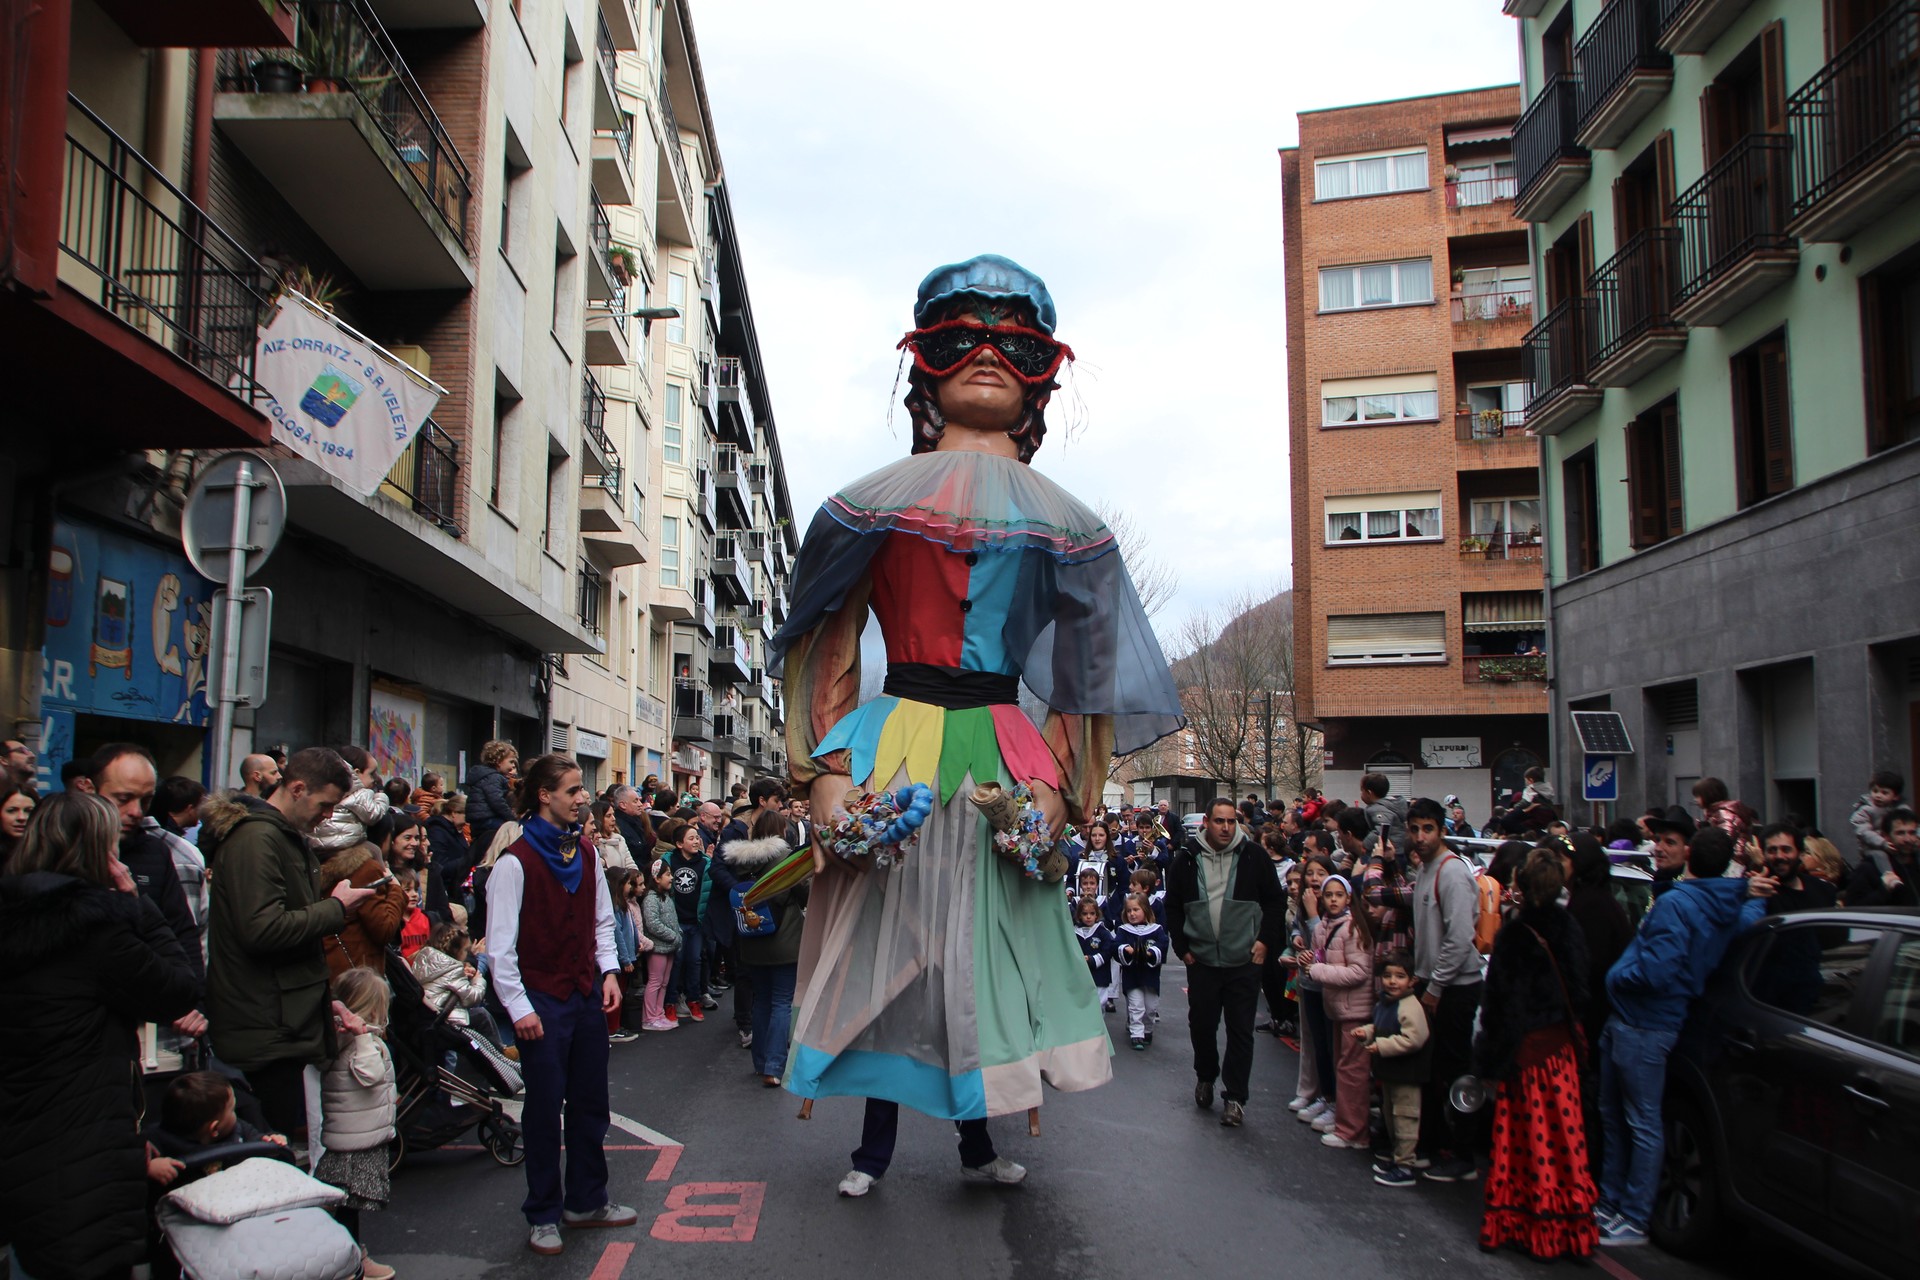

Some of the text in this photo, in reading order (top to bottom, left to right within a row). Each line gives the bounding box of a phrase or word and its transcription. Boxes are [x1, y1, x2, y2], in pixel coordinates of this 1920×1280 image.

[263, 338, 352, 362] AIZ-ORRATZ
[382, 387, 408, 441] VELETA
[265, 398, 311, 446] TOLOSA
[321, 441, 354, 461] 1984
